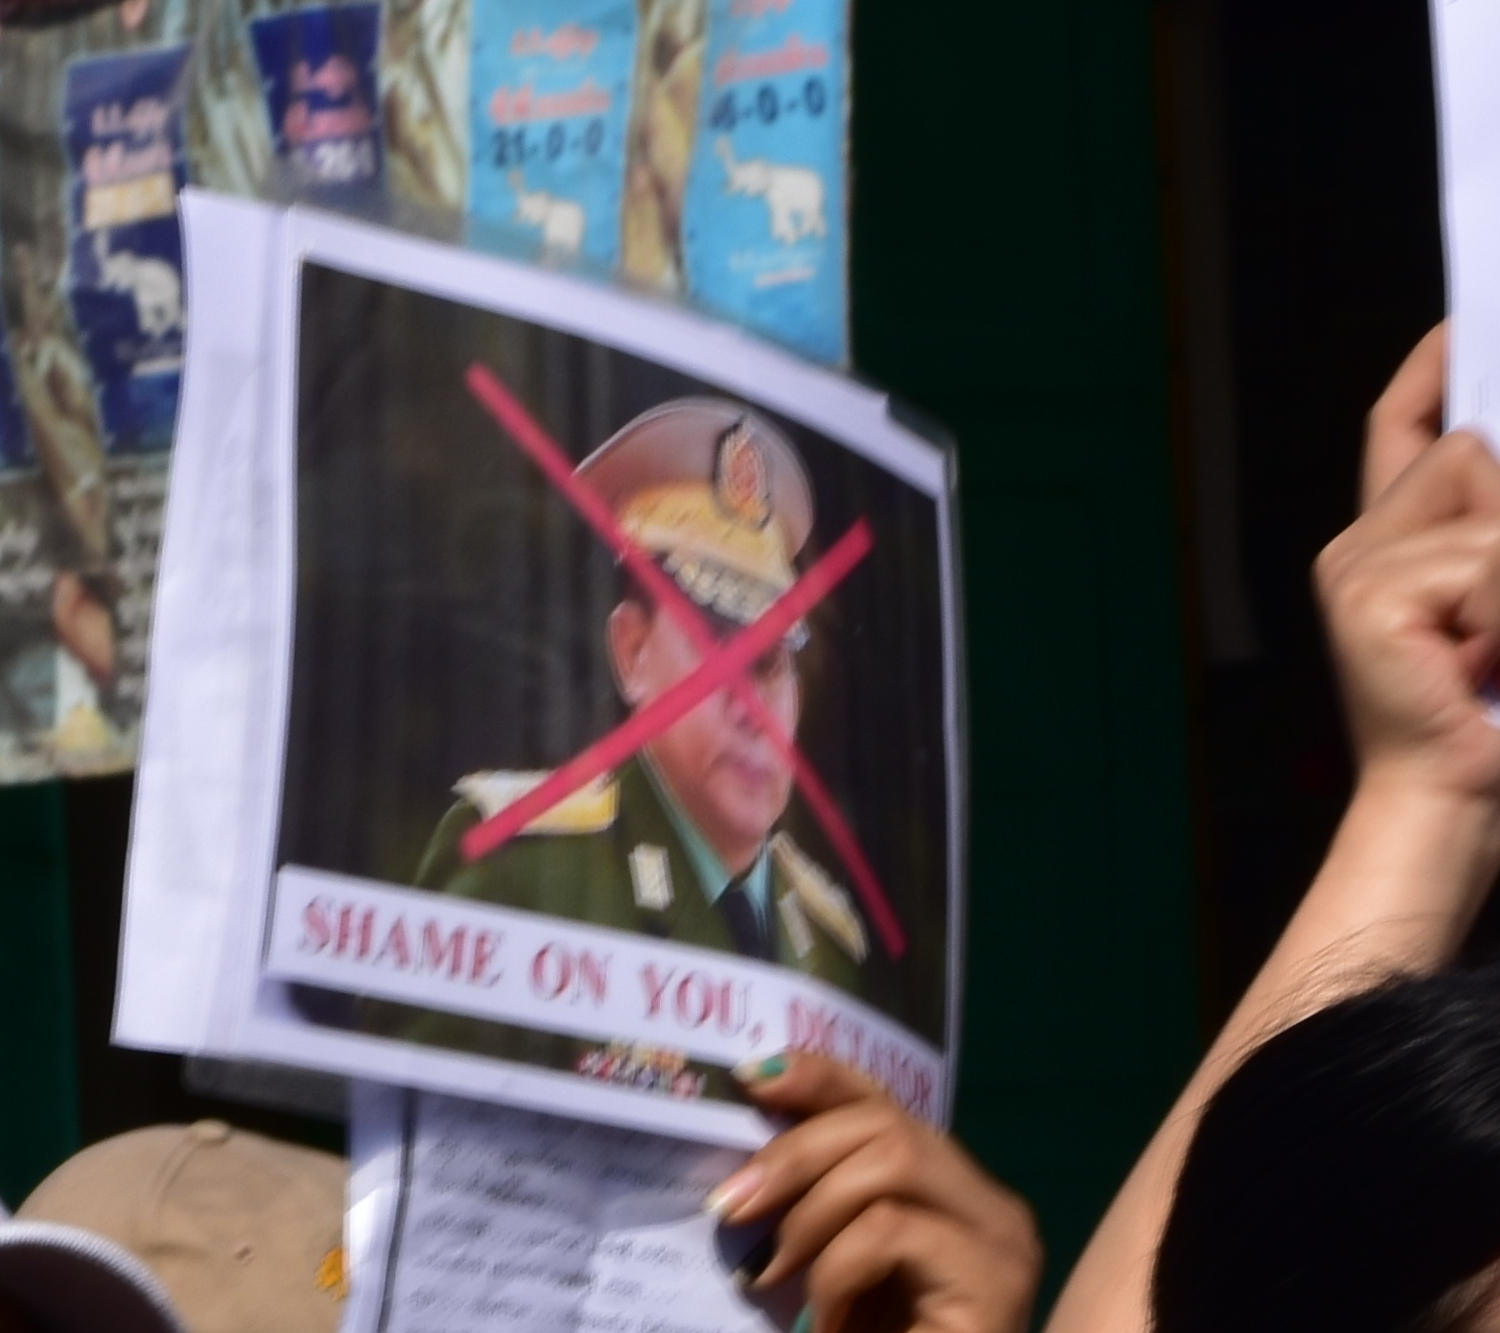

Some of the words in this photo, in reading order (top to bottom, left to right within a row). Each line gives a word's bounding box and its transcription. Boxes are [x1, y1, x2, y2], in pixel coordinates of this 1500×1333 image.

[301, 896, 504, 989] SHAME
[532, 938, 609, 1006] ON
[640, 964, 767, 1047] YOU,
